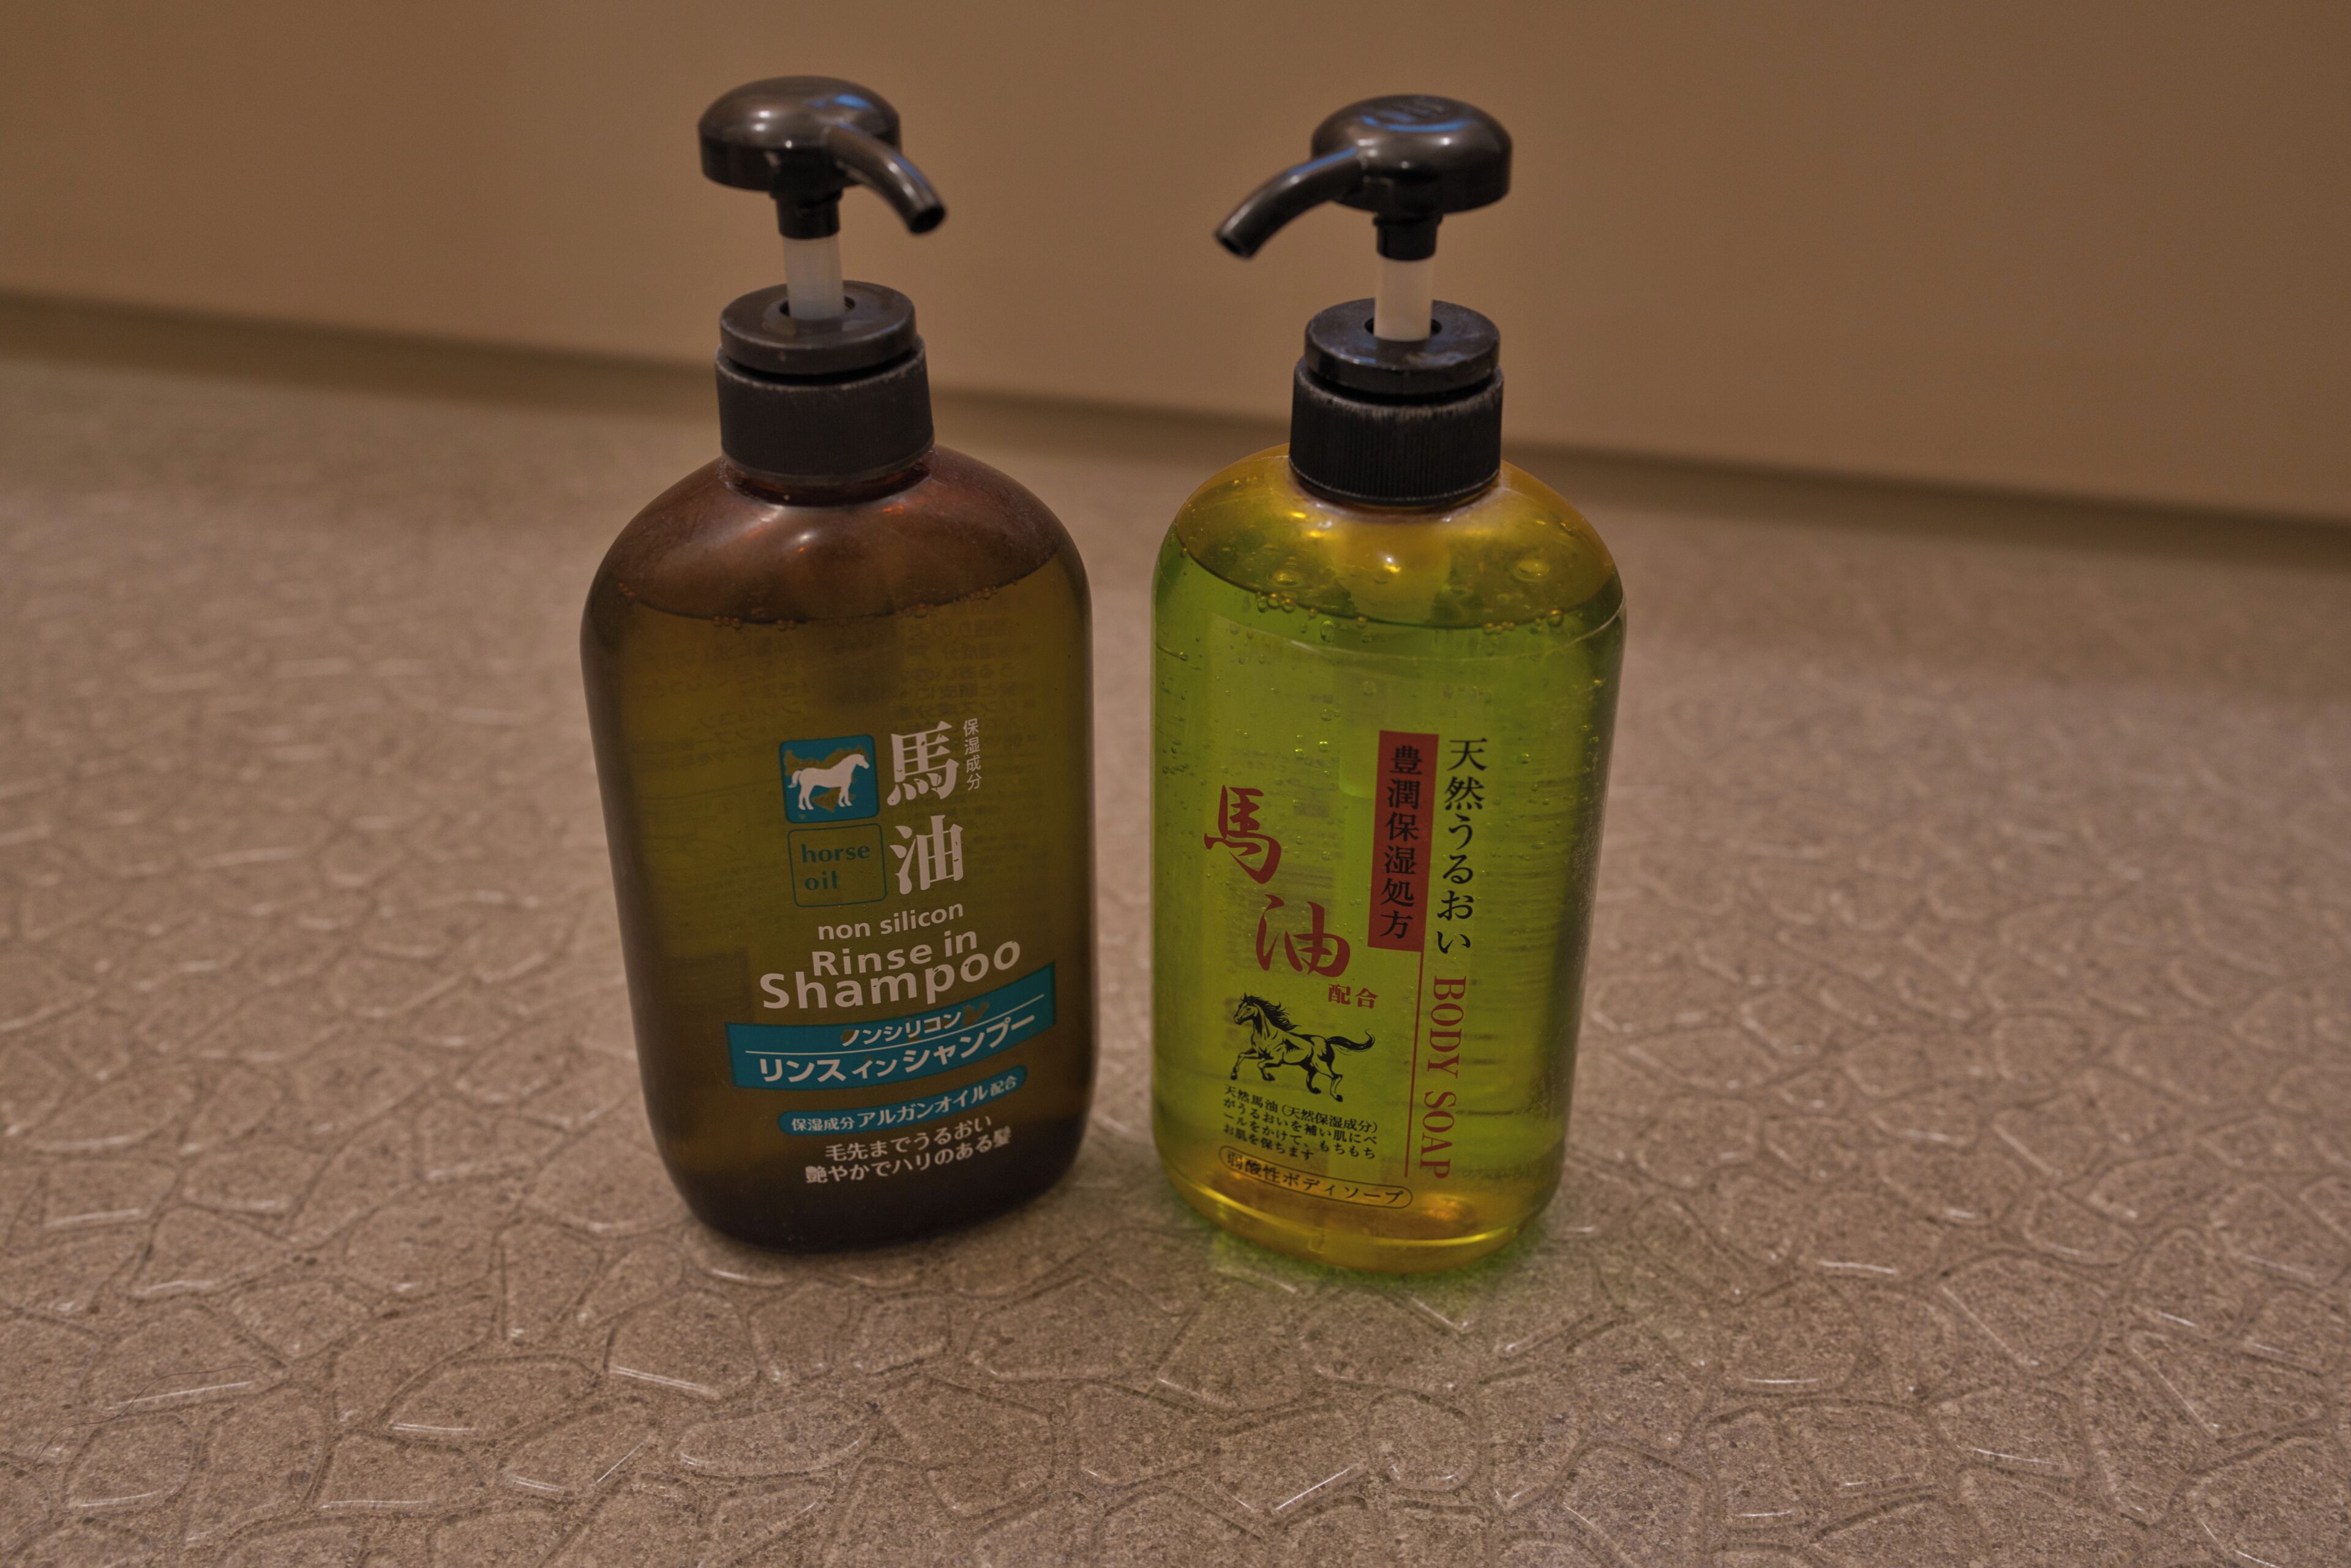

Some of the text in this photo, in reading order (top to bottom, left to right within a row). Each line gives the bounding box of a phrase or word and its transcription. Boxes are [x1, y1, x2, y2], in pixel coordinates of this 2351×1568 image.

[963, 718, 983, 792] 保湿成分
[887, 721, 964, 895] 馬油
[801, 842, 871, 864] horse
[1379, 745, 1423, 939] 豊潤保湿処方
[1436, 737, 1488, 954] 天然うるおい
[804, 870, 839, 891] oil
[1204, 784, 1351, 977] 馬油
[817, 903, 964, 941] non silicon
[760, 940, 1021, 1009] Shampoo
[812, 929, 978, 977] Rinse in
[1327, 983, 1379, 1009] 配合
[759, 1015, 1035, 1083] リンスインシャンプー
[841, 1012, 961, 1046] ノンシリコン
[792, 1076, 1018, 1133] 保湿成分アルガンオイル配合
[1419, 976, 1466, 1179] BODY SOAP
[804, 1126, 1012, 1184] 艶やかでハリのある髪
[825, 1116, 992, 1162] 毛先までうるおい
[1226, 1150, 1404, 1205] 弱酸性ボディソープ
